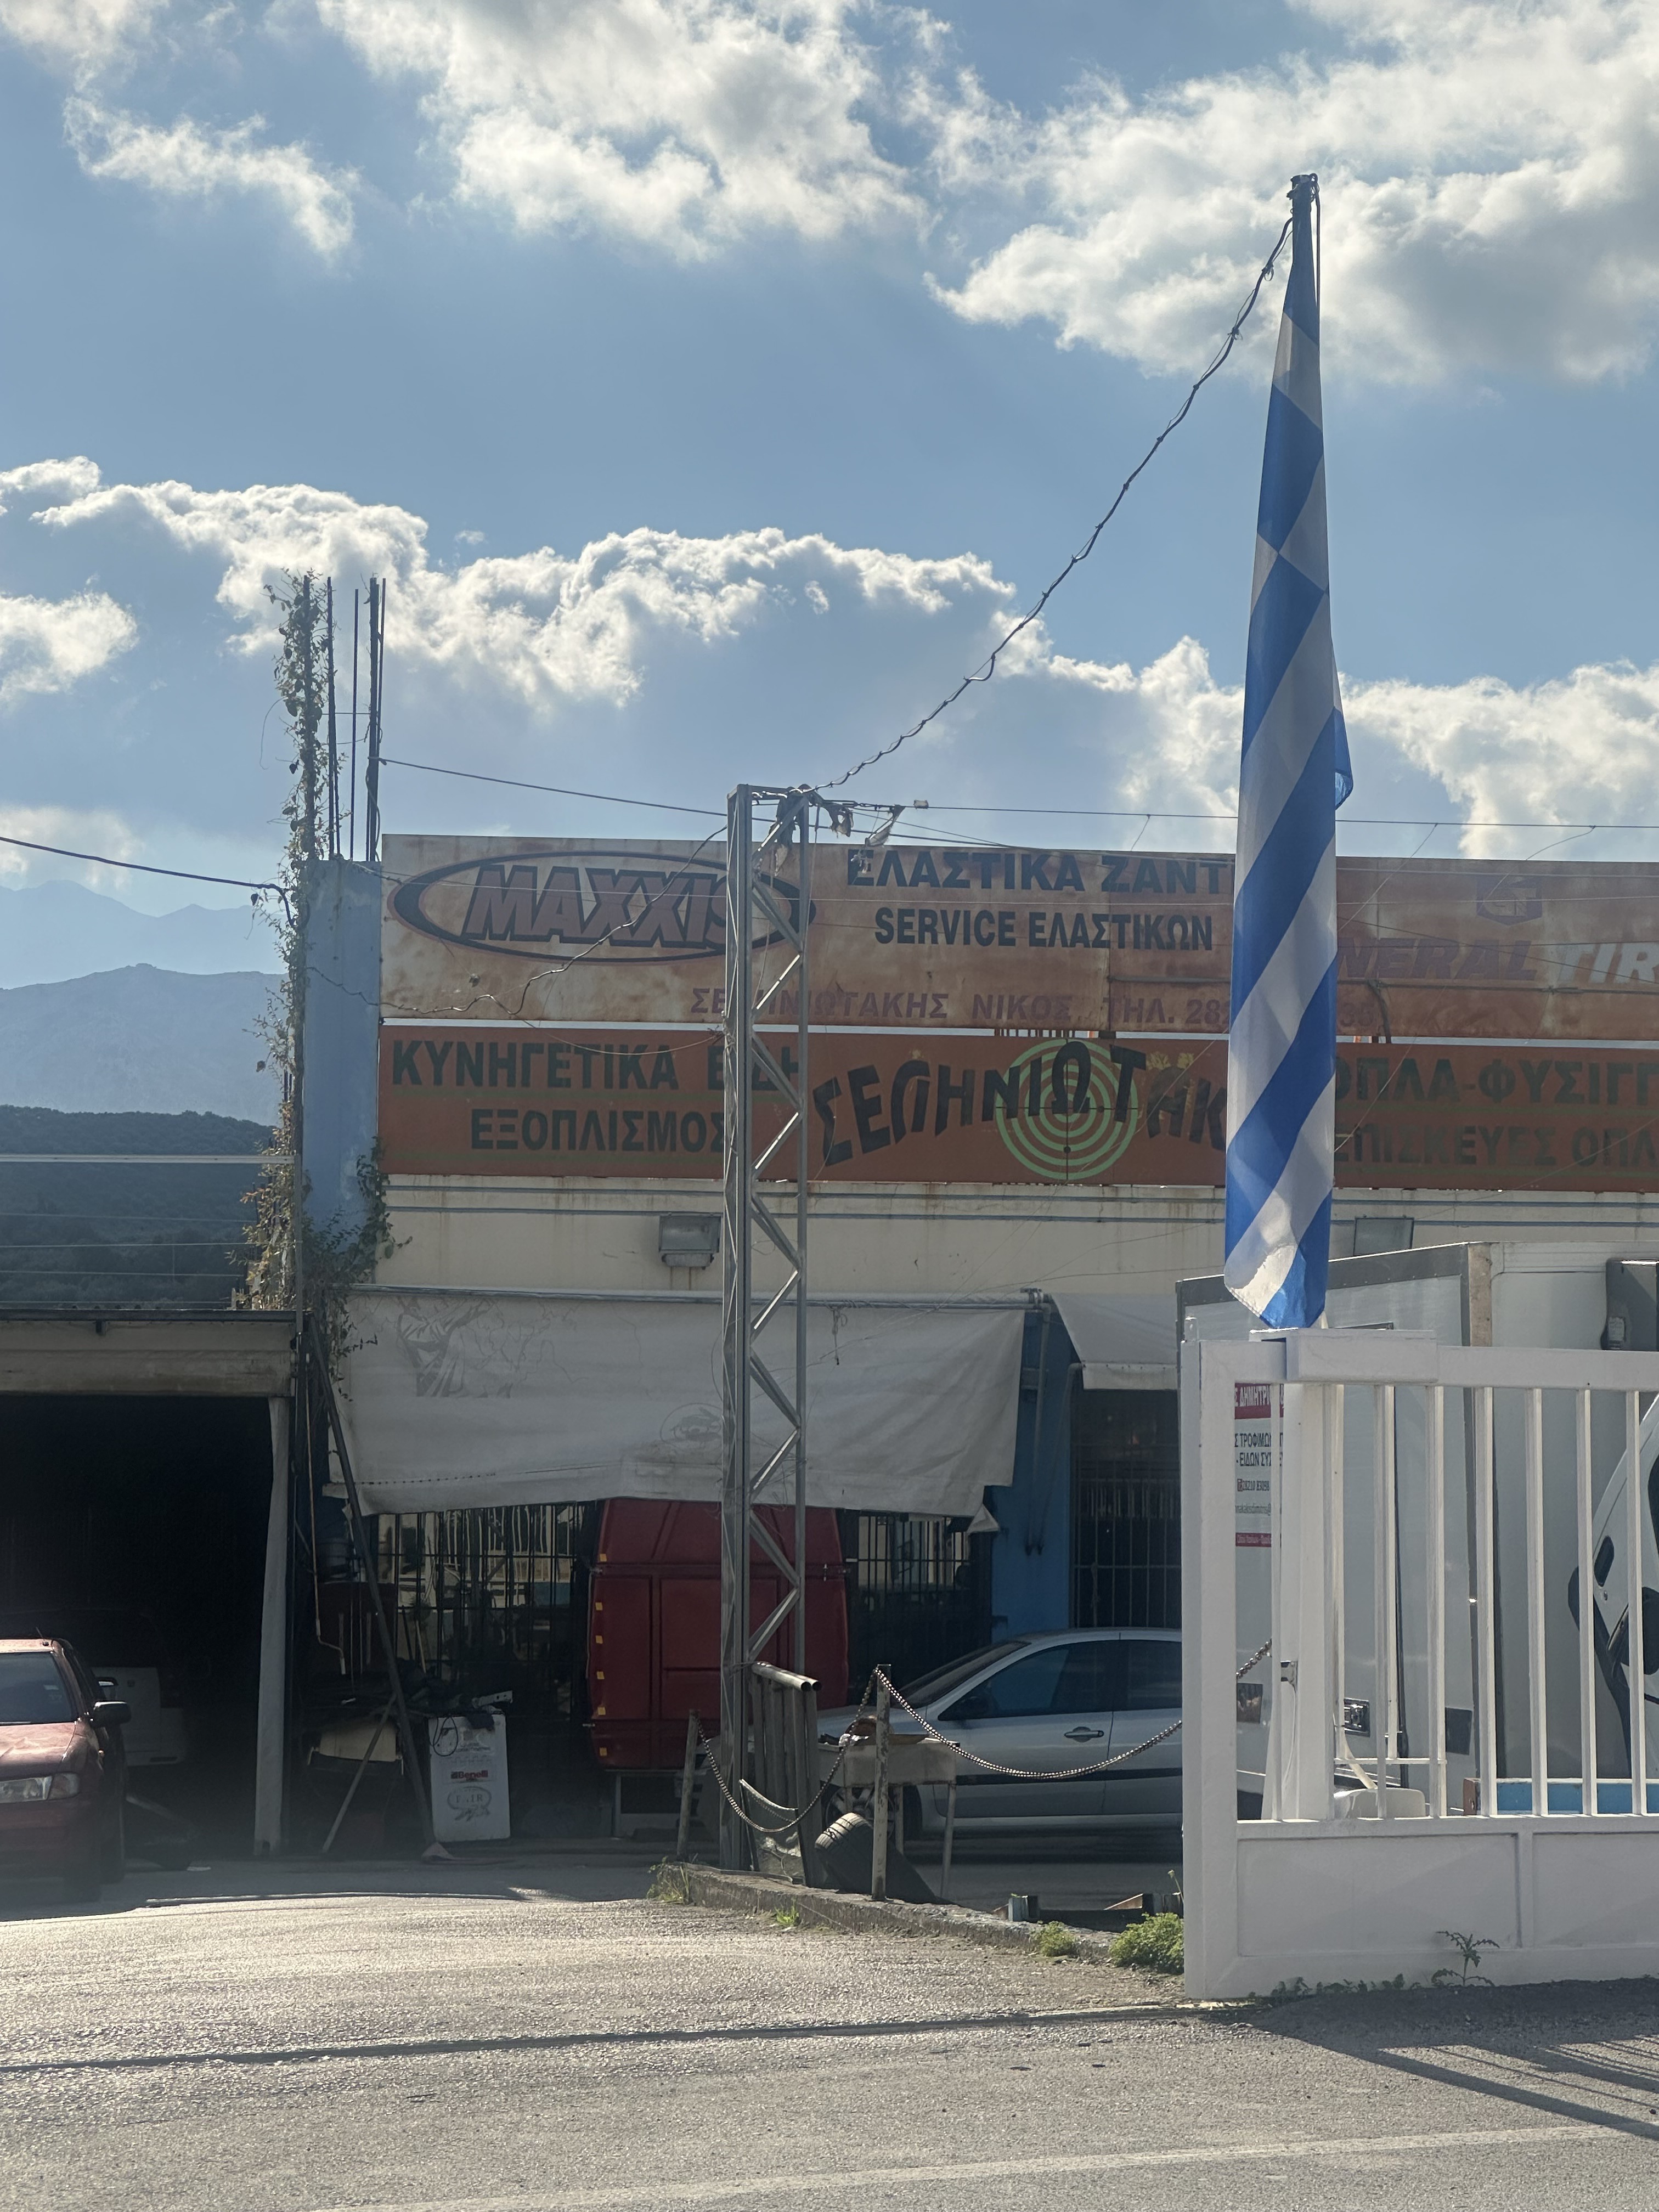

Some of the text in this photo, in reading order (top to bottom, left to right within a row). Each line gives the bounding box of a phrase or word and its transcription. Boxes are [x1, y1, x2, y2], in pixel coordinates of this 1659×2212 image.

[848, 849, 1234, 894] ΕΛΑΣΤΙΚΑ ΖΑΝΤ
[874, 907, 1212, 951] SERVICE ΕΛΑΣΤΙΚΩΝ
[1337, 938, 1538, 981] NERAL
[690, 987, 949, 1019] ΣΕΗΝΙΩΤΑΚΗΣ
[972, 994, 1073, 1022] ΝΙΚΟΣ
[392, 1040, 679, 1091] ΚΥΝΗΓΕΤΙΚΑ
[1240, 1385, 1271, 1407] ΔΗΜΗΤΡΙ
